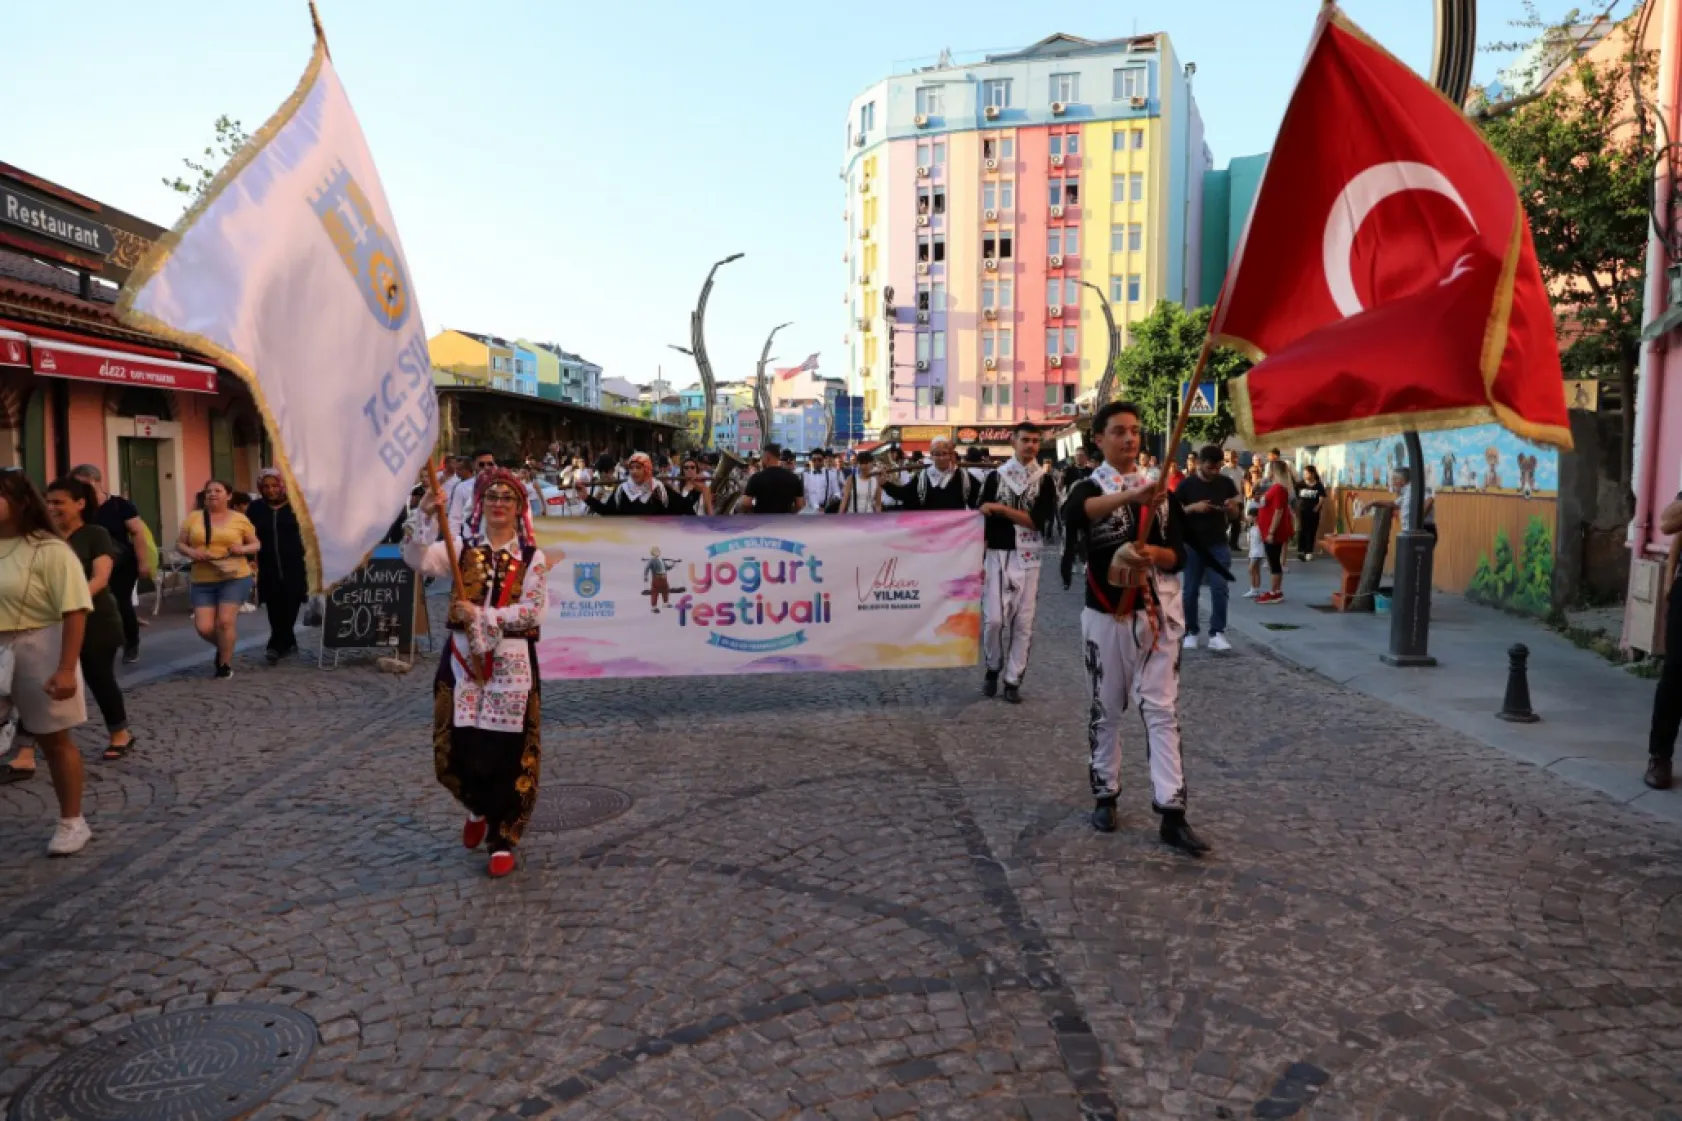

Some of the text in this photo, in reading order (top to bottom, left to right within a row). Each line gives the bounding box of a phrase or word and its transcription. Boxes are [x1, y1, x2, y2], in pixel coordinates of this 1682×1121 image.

[6, 193, 100, 249] Restaurant
[688, 555, 823, 593] yoğurt
[675, 592, 831, 626] festivali
[873, 589, 920, 601] YILMAZ
[336, 604, 372, 639] 30
